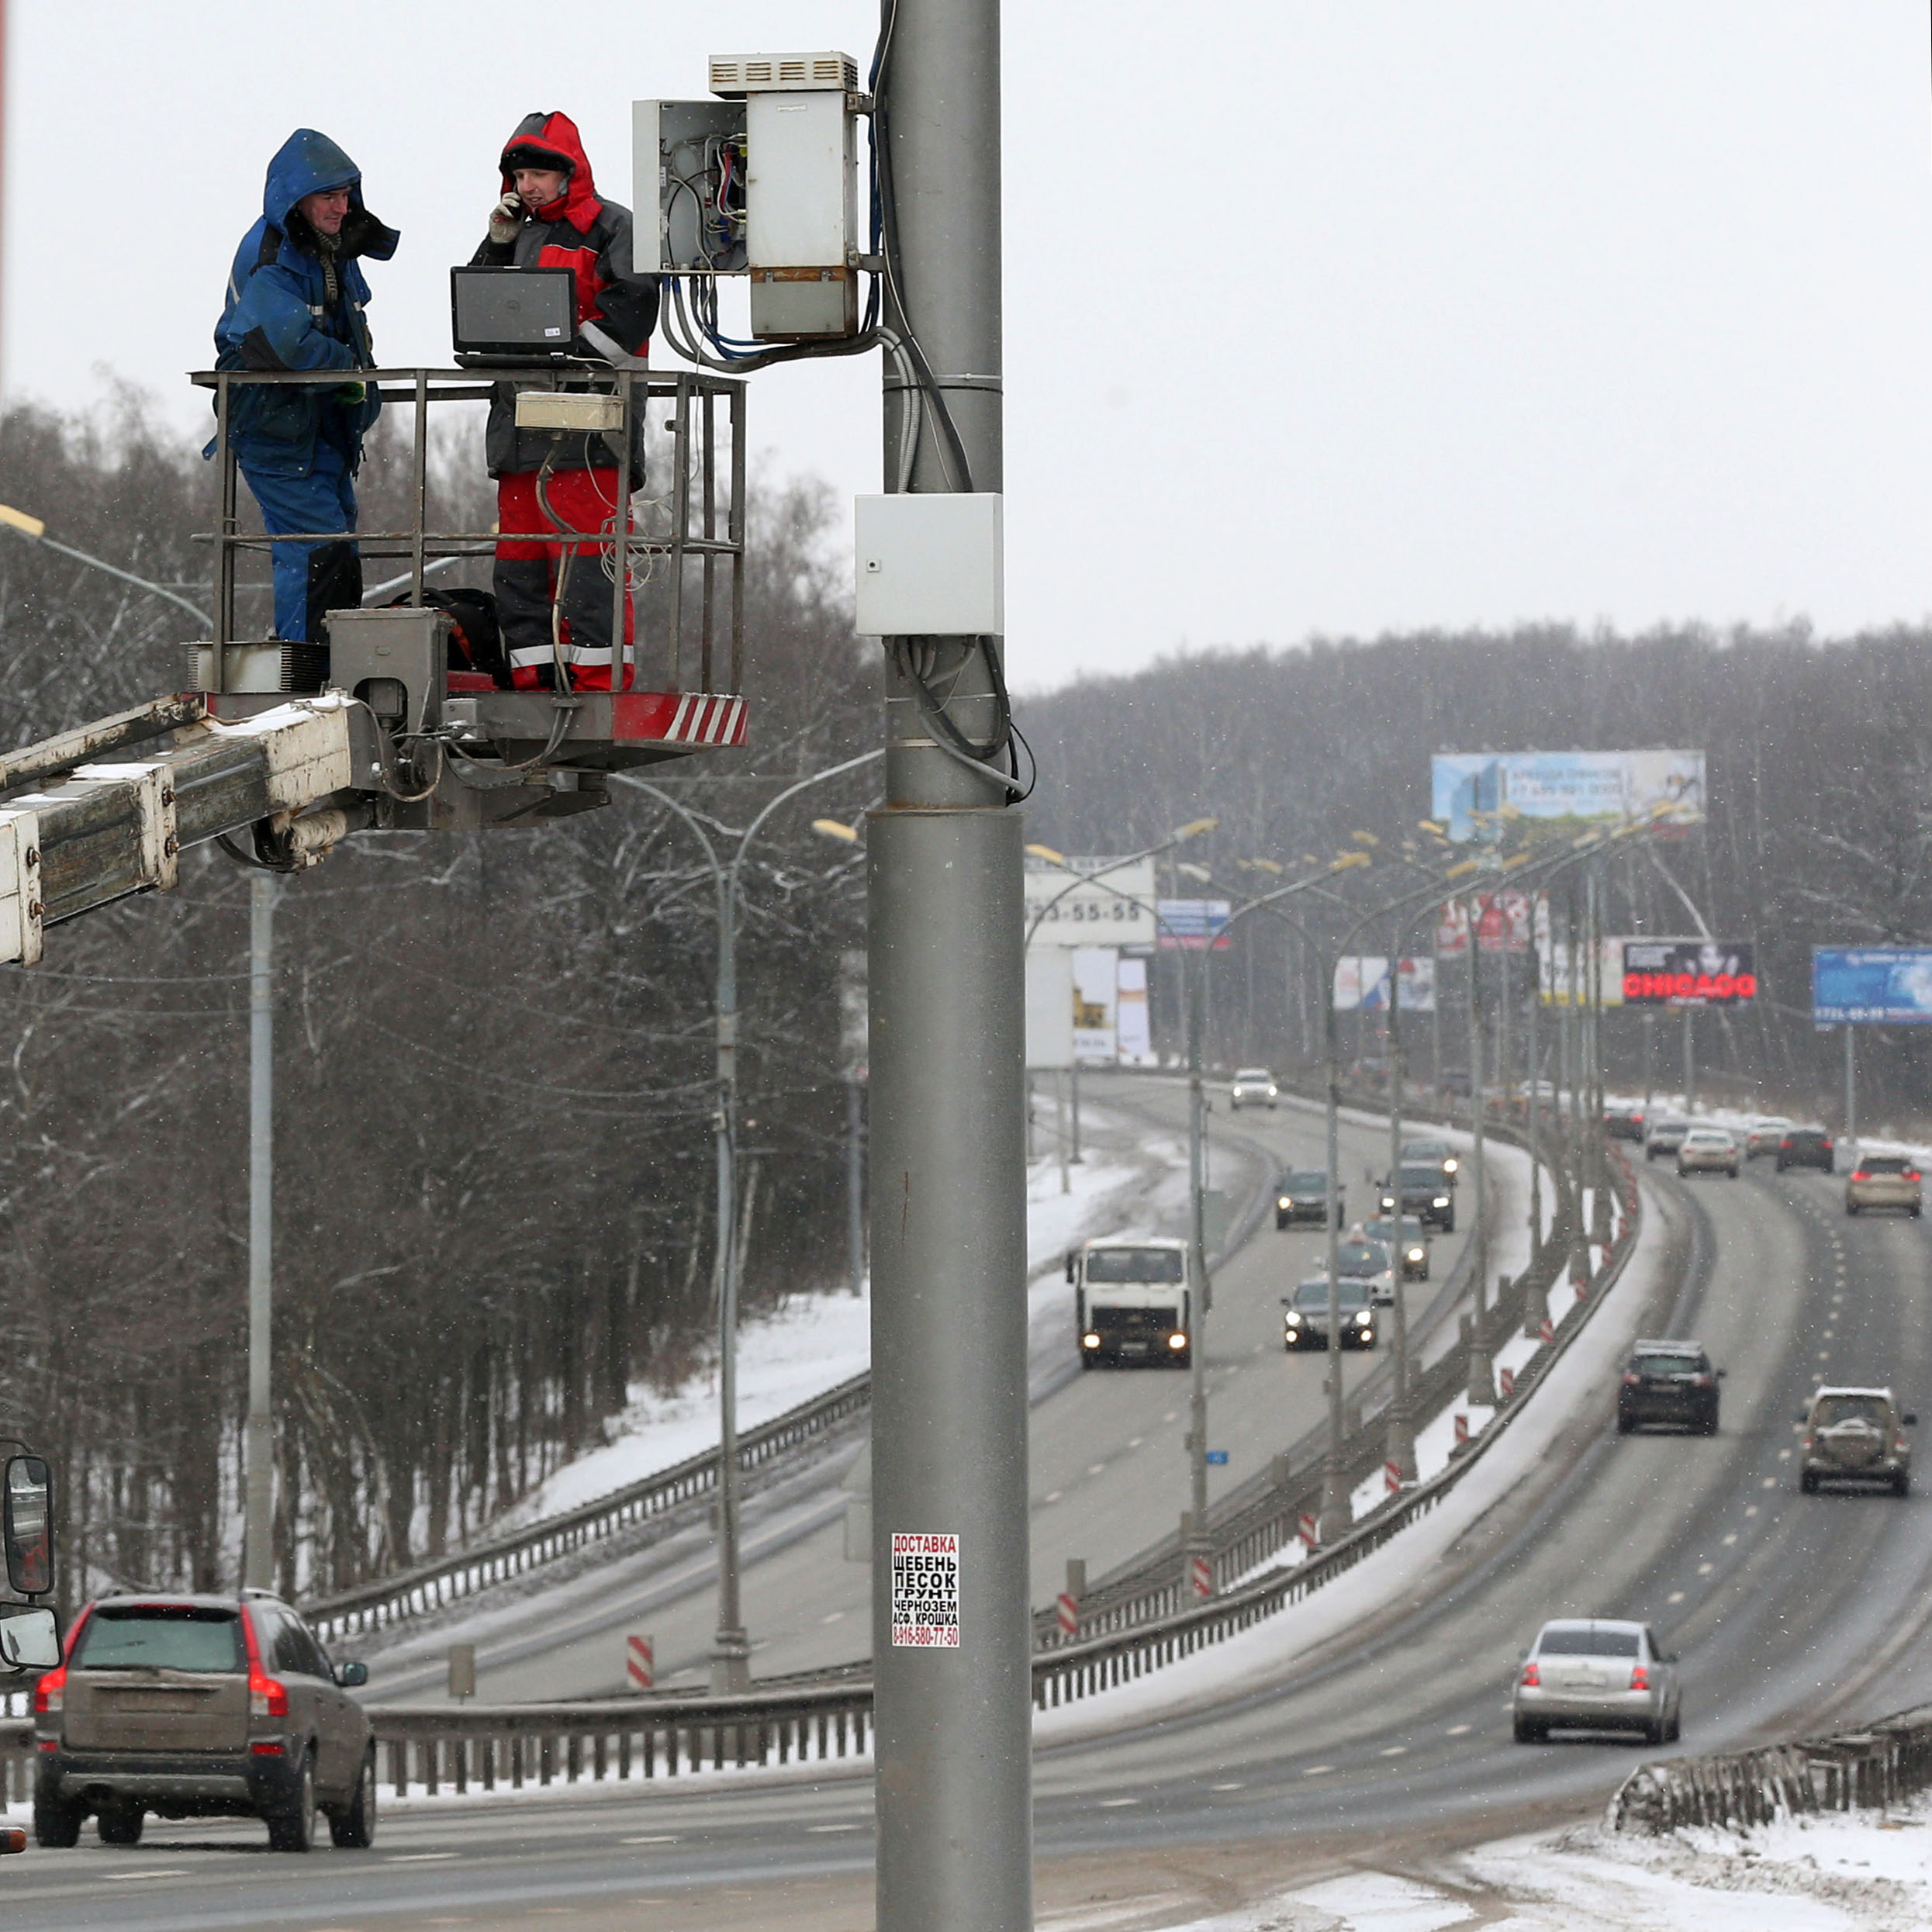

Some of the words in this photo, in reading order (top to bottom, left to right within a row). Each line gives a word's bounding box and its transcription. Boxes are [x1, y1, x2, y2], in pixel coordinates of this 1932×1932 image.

[893, 1535, 956, 1554] ДОСТАВКА
[893, 1556, 956, 1571] ЩЕБЕНЬ
[895, 1572, 956, 1588] ПЕСОК
[895, 1588, 956, 1598] ГРУНТ
[894, 1600, 957, 1612] ЧЕРНОЗЕМ
[893, 1612, 913, 1625] АСФ.
[915, 1613, 958, 1626] КРОШКА
[893, 1626, 958, 1645] 8-916-580-77-50
